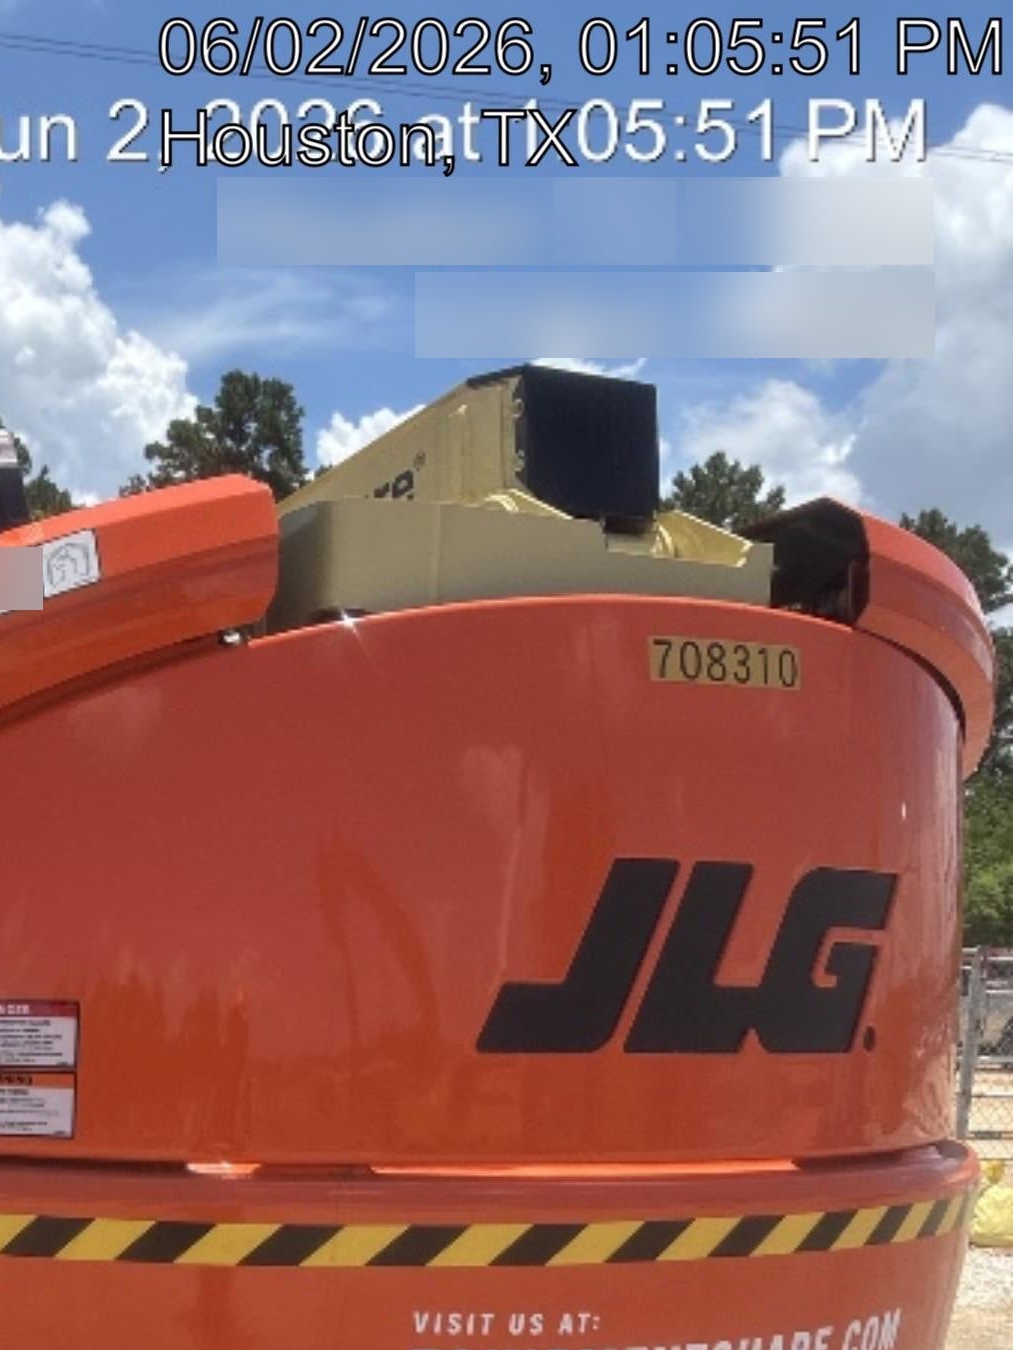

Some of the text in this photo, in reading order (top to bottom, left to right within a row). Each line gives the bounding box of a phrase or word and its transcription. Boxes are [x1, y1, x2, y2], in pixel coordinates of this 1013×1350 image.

[653, 638, 799, 688] 708310
[476, 856, 899, 1054] JLG
[413, 1312, 602, 1336] VISIT US AT:
